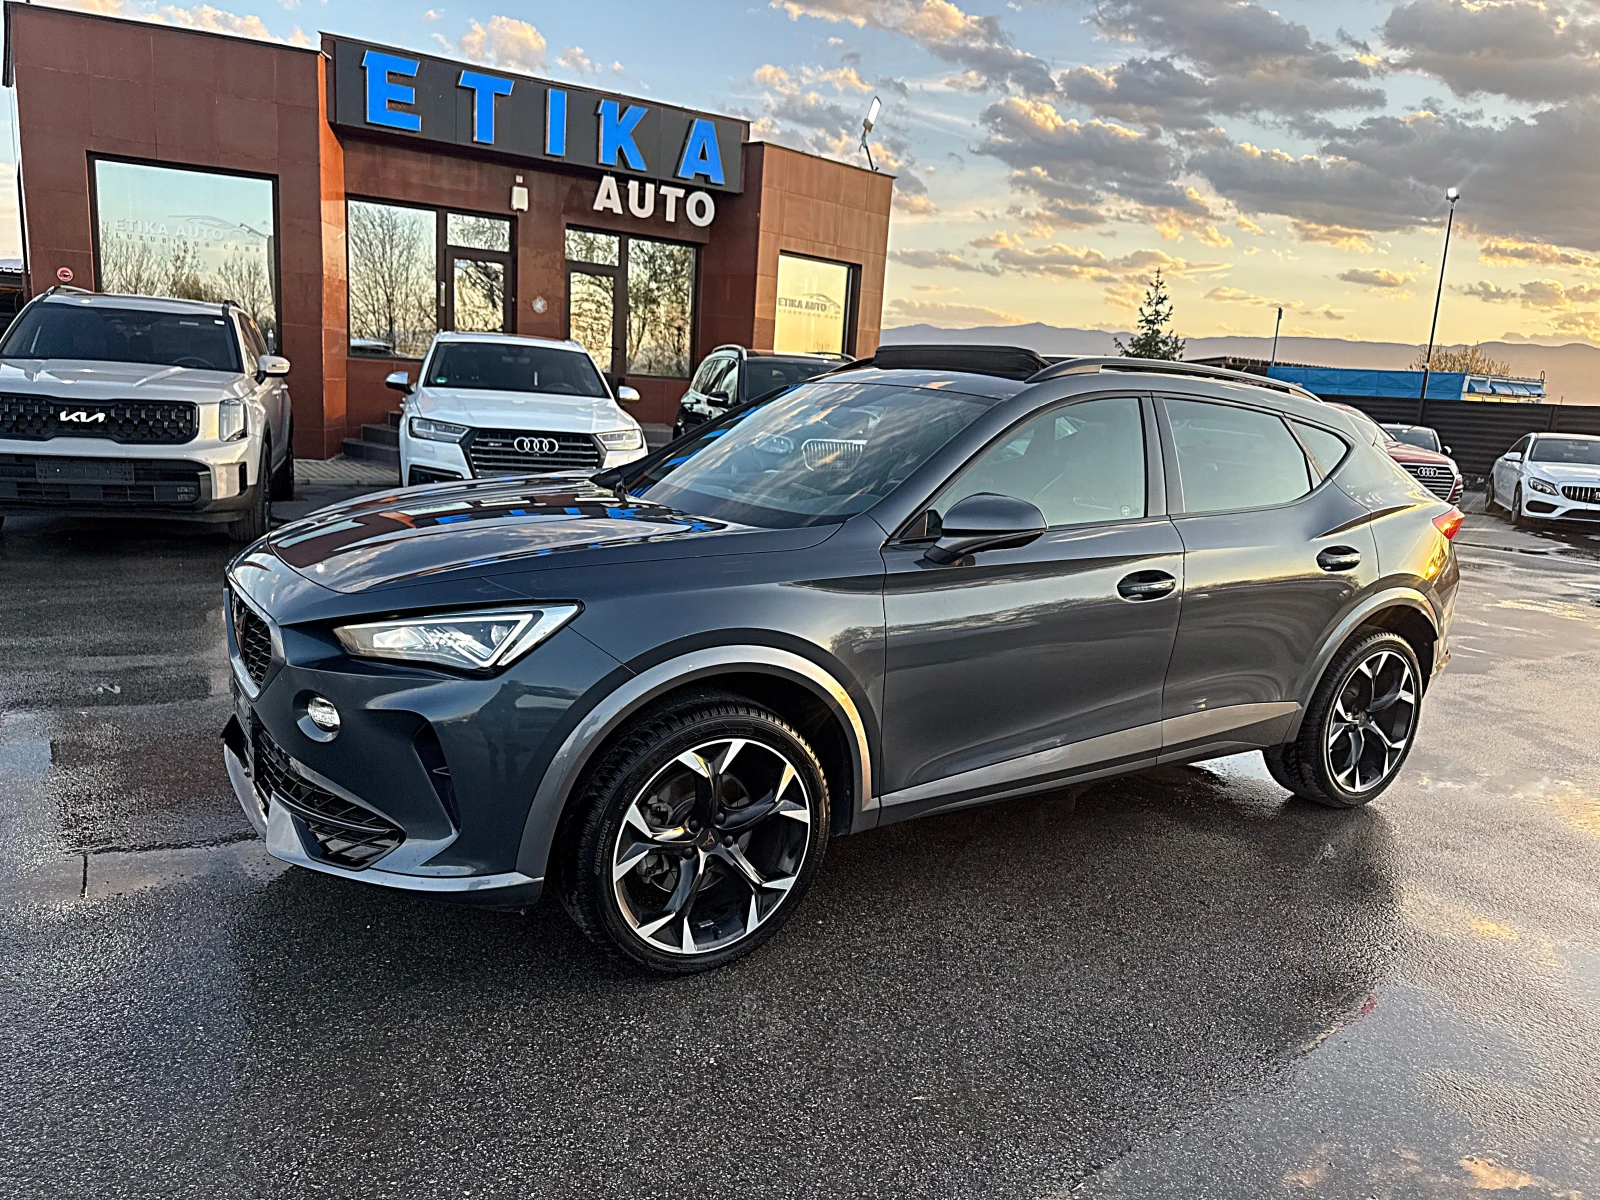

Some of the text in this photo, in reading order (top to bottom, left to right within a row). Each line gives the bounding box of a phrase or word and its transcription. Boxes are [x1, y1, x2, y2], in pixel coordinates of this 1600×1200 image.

[361, 50, 725, 185] ETIKA
[592, 175, 716, 228] AUTO
[115, 219, 224, 241] ETIKA AUTO
[778, 298, 827, 312] ETIKA AUTO
